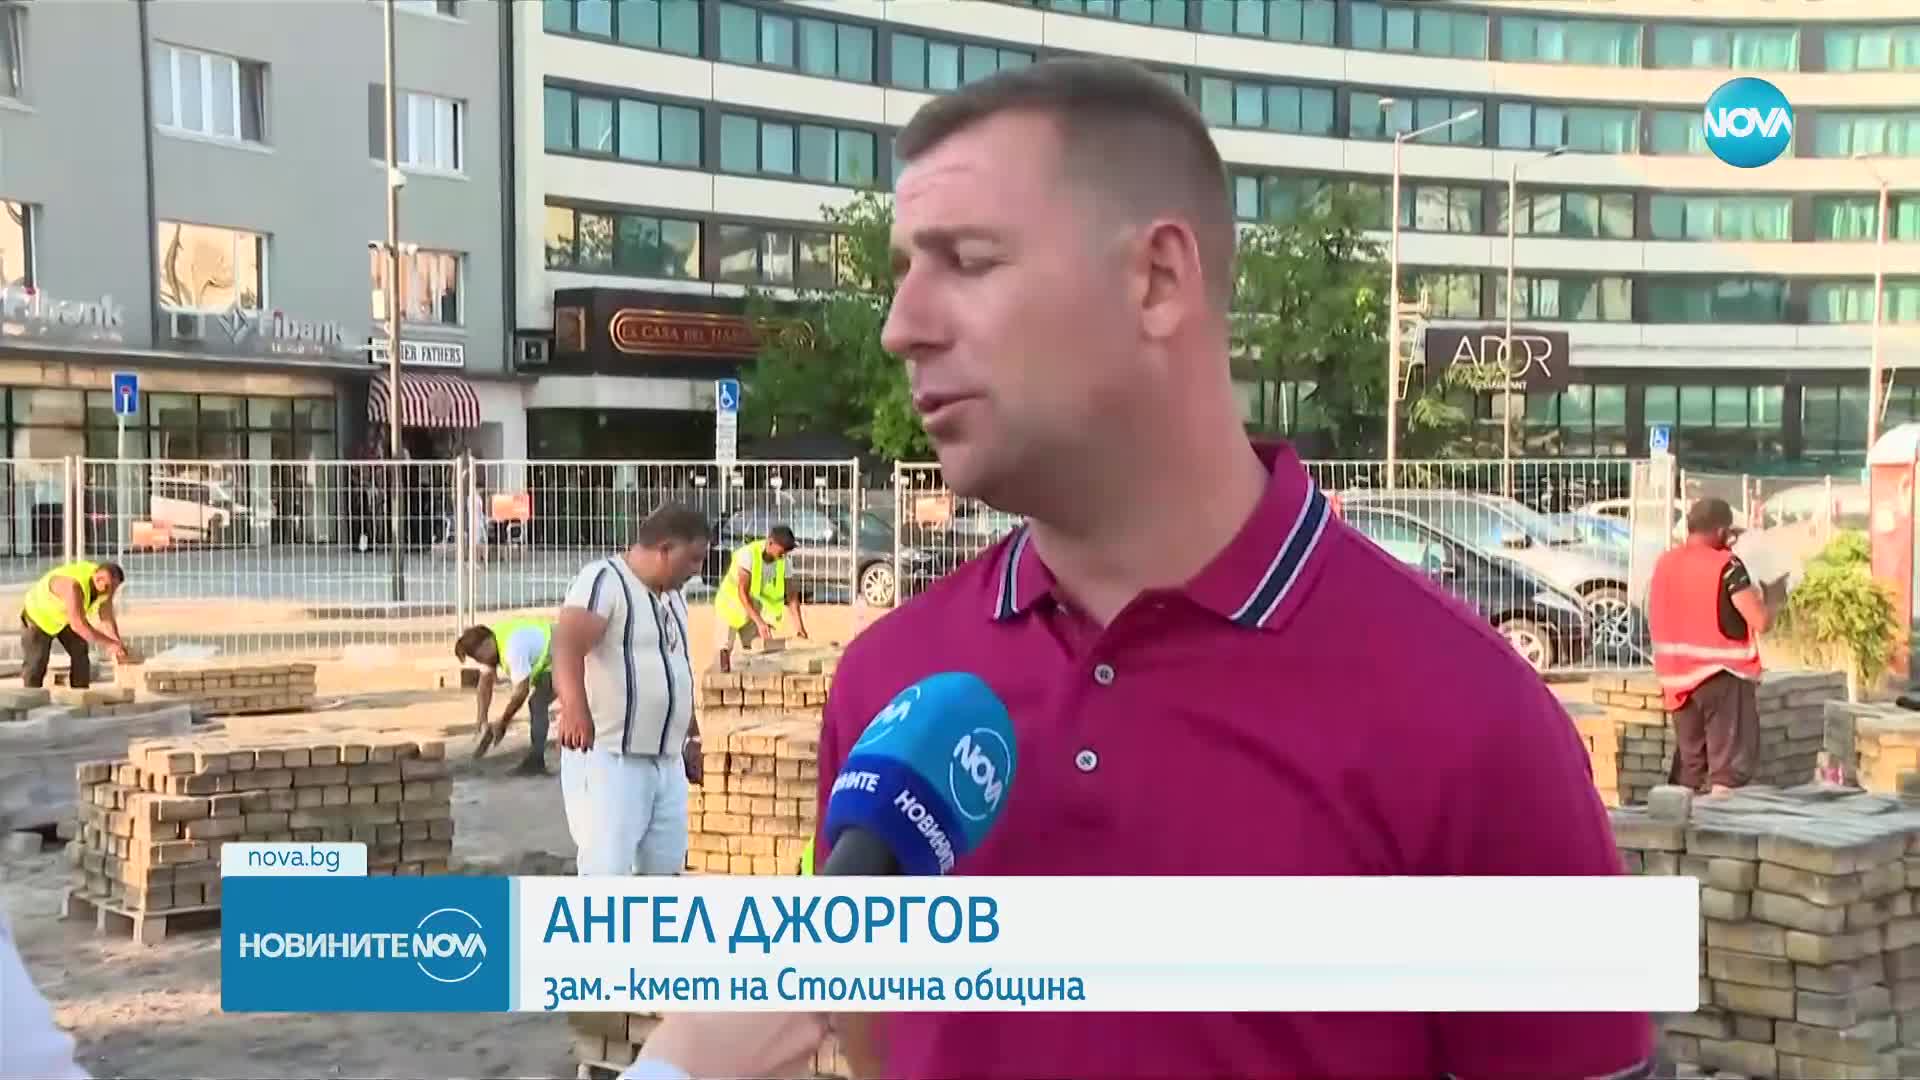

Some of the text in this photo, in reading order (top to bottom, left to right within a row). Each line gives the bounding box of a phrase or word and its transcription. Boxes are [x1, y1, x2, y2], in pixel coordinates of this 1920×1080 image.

[641, 326, 679, 341] CASA
[421, 345, 461, 363] FATHERS
[1449, 335, 1552, 378] ADOR
